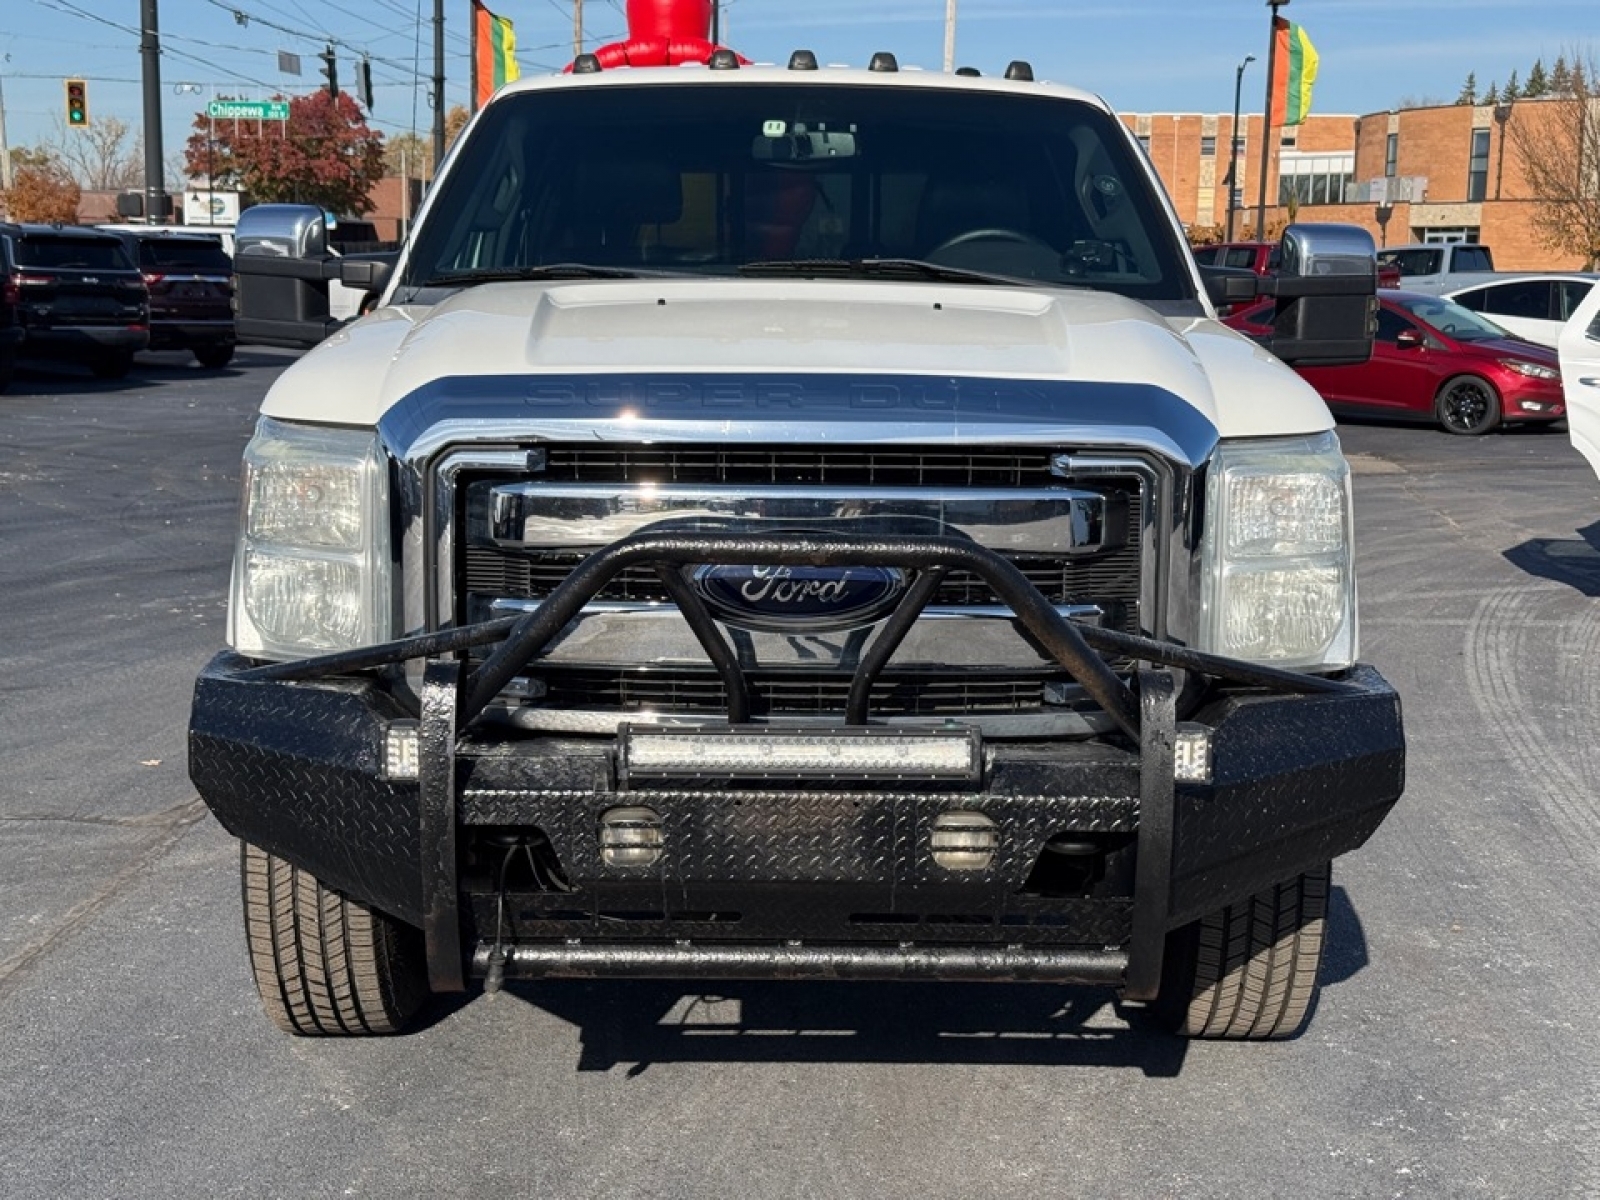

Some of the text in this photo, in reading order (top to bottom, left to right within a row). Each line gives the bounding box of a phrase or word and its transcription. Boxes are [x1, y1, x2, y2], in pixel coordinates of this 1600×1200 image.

[209, 102, 264, 118] Chippewa
[523, 381, 804, 409] SUPER
[741, 565, 852, 602] Ford
